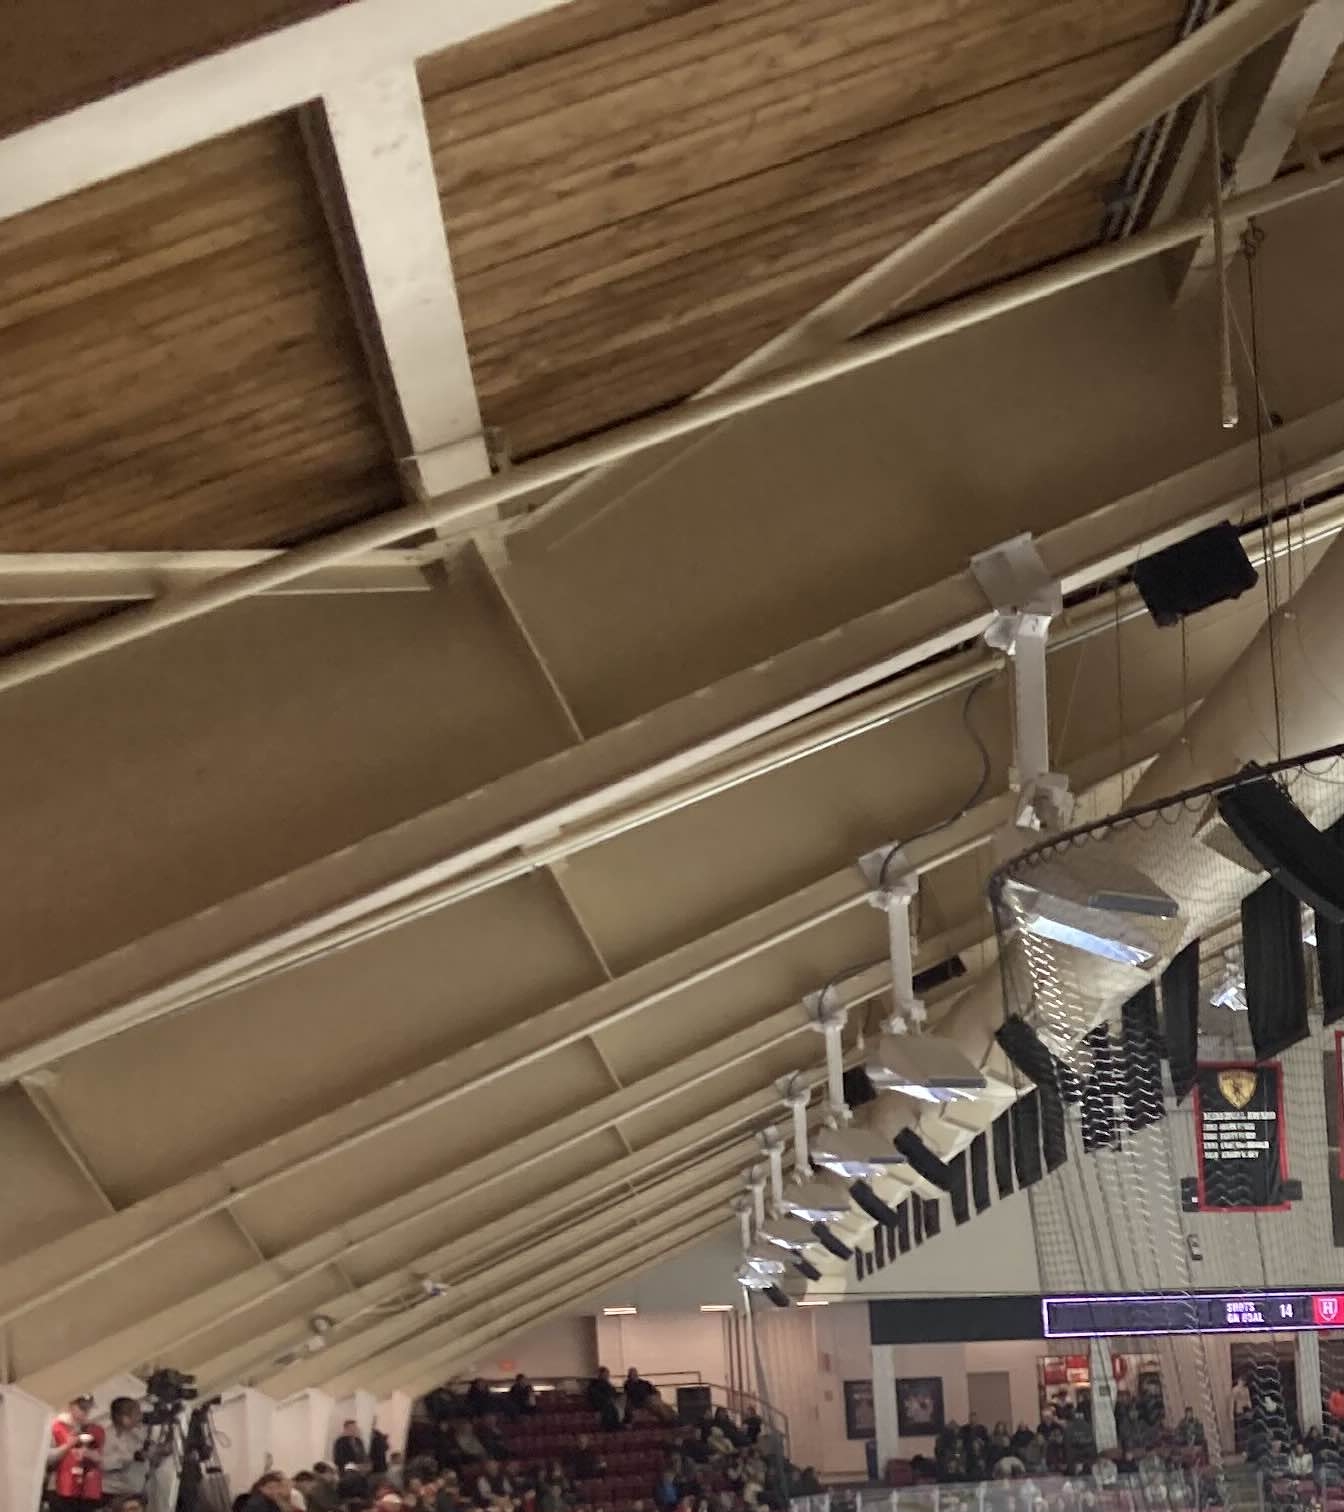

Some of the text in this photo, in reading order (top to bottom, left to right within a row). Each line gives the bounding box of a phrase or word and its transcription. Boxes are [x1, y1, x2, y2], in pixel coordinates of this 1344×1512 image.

[1226, 1302, 1255, 1312] SHOTS
[1280, 1304, 1294, 1318] 14
[1323, 1302, 1334, 1315] H
